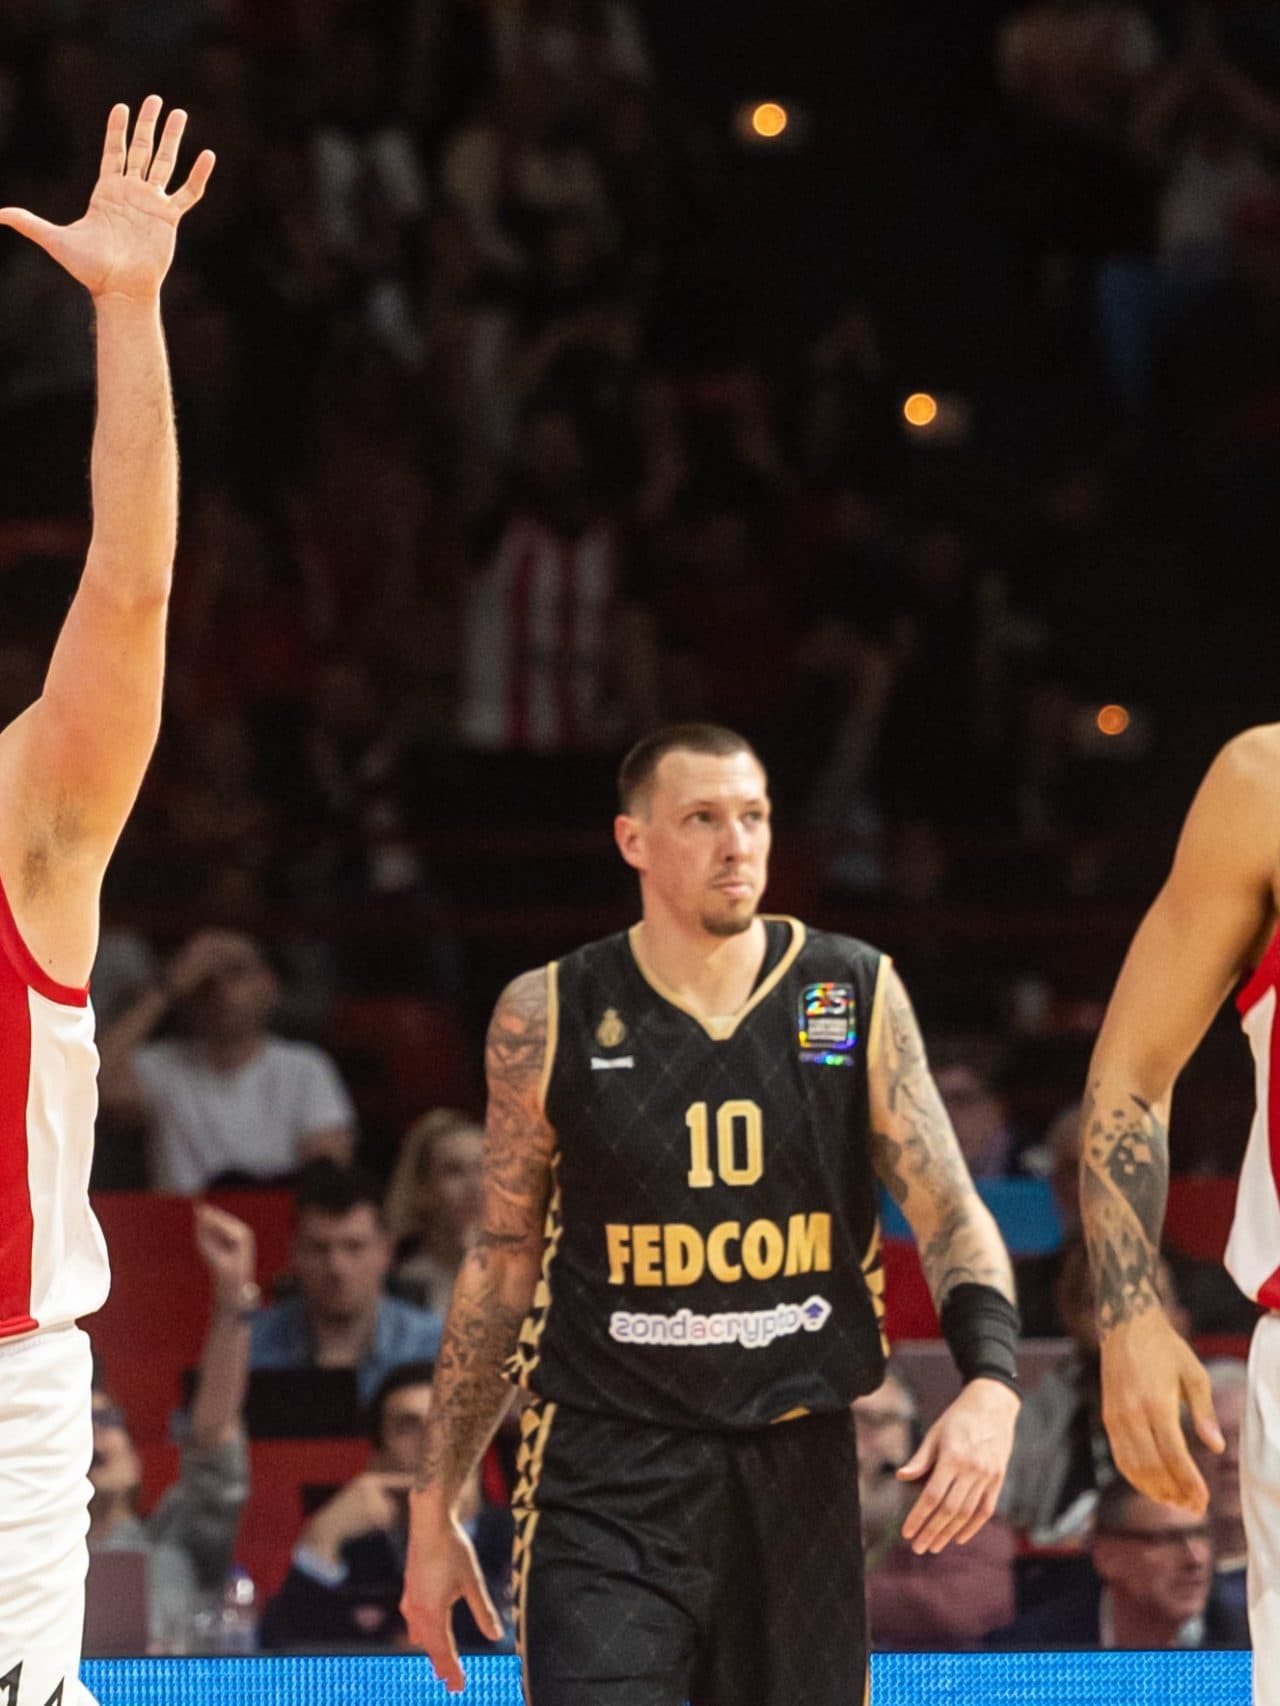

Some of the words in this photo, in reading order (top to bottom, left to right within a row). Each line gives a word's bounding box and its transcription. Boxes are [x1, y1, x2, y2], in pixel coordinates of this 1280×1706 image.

[685, 1099, 763, 1188] 10
[605, 1212, 831, 1287] FEDCOM
[614, 1308, 799, 1343] zondacrypto
